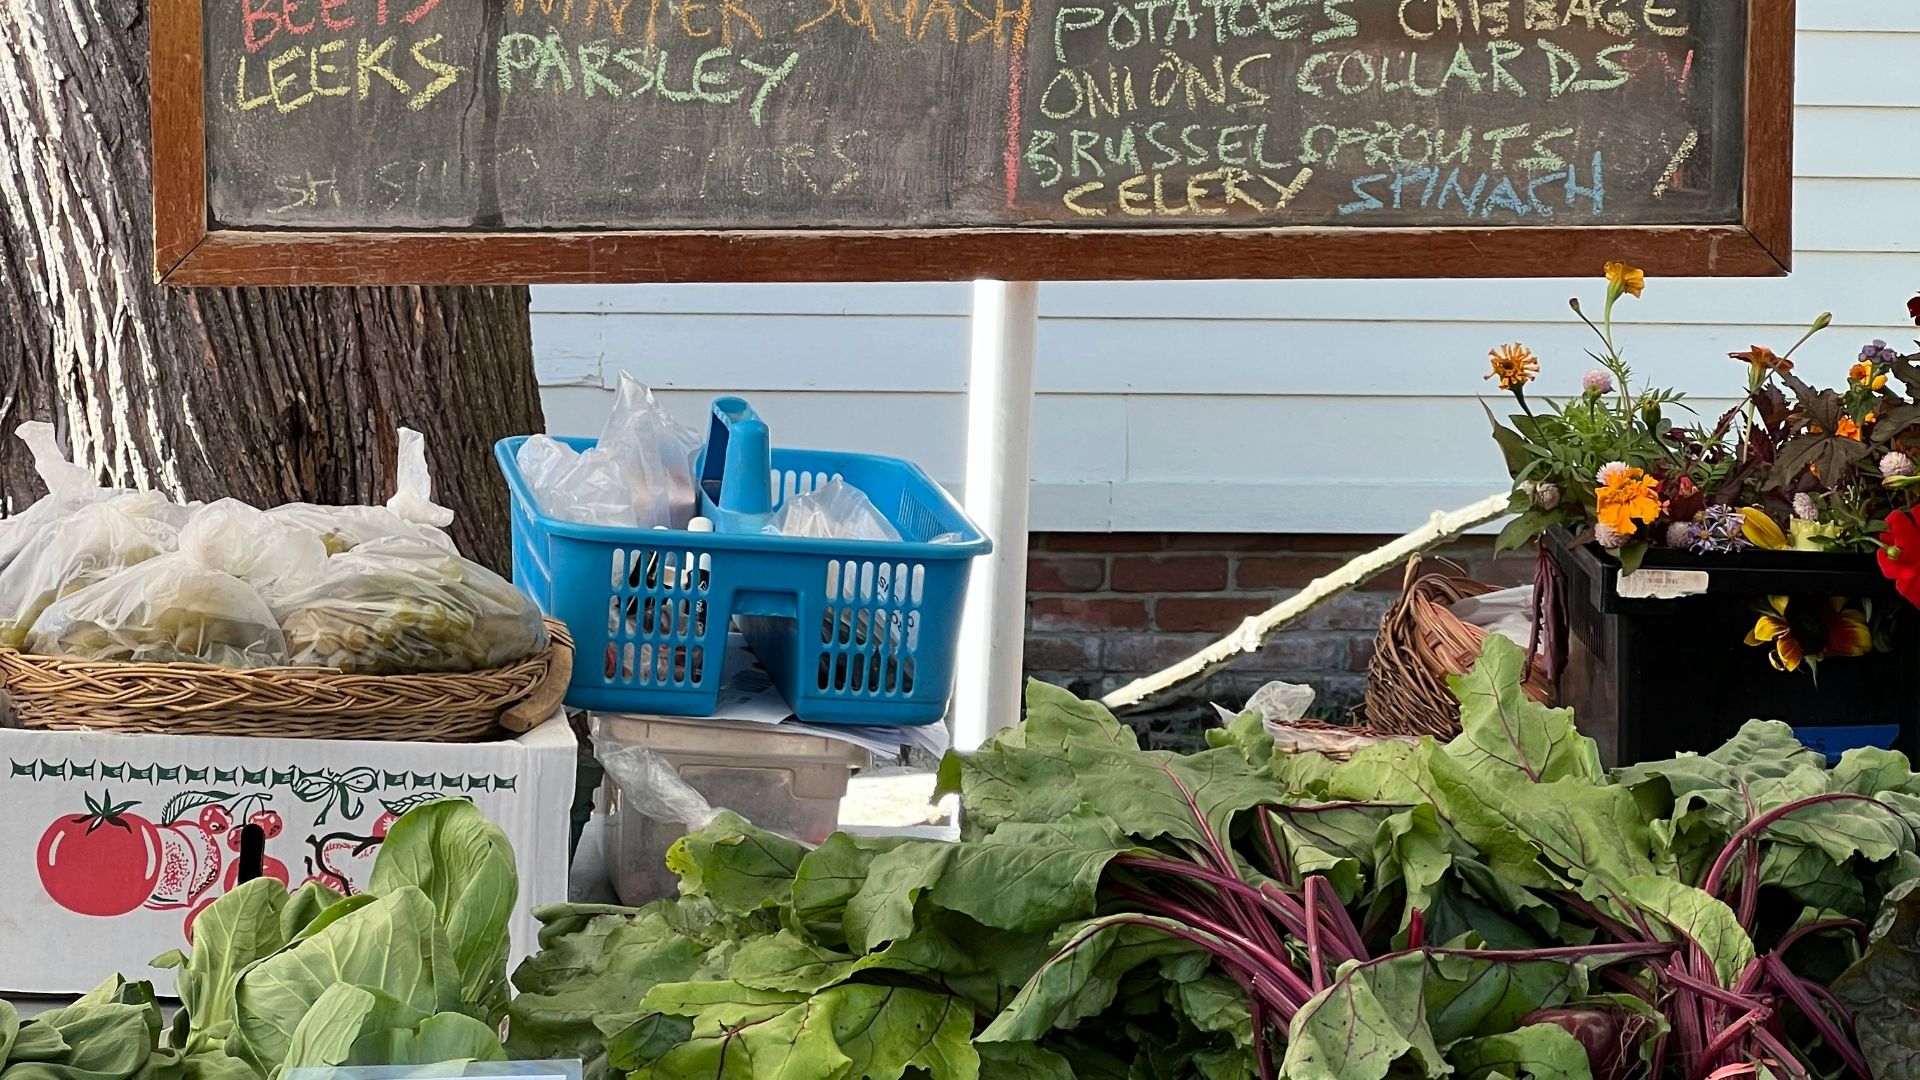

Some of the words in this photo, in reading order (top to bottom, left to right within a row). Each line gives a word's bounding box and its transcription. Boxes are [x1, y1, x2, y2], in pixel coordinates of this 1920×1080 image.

[1055, 0, 1359, 62] POTATOES
[1398, 0, 1690, 41] CABBAGE
[237, 33, 462, 113] LEEKS
[497, 30, 799, 127] PARSLEY
[1040, 50, 1272, 119] ONIONS
[1297, 38, 1637, 100] COLLARDS
[1024, 121, 1291, 188] BRUSSEL
[1299, 120, 1574, 171] SPROUTS
[1338, 151, 1606, 217] SPINACH
[1063, 165, 1314, 217] CELERY
